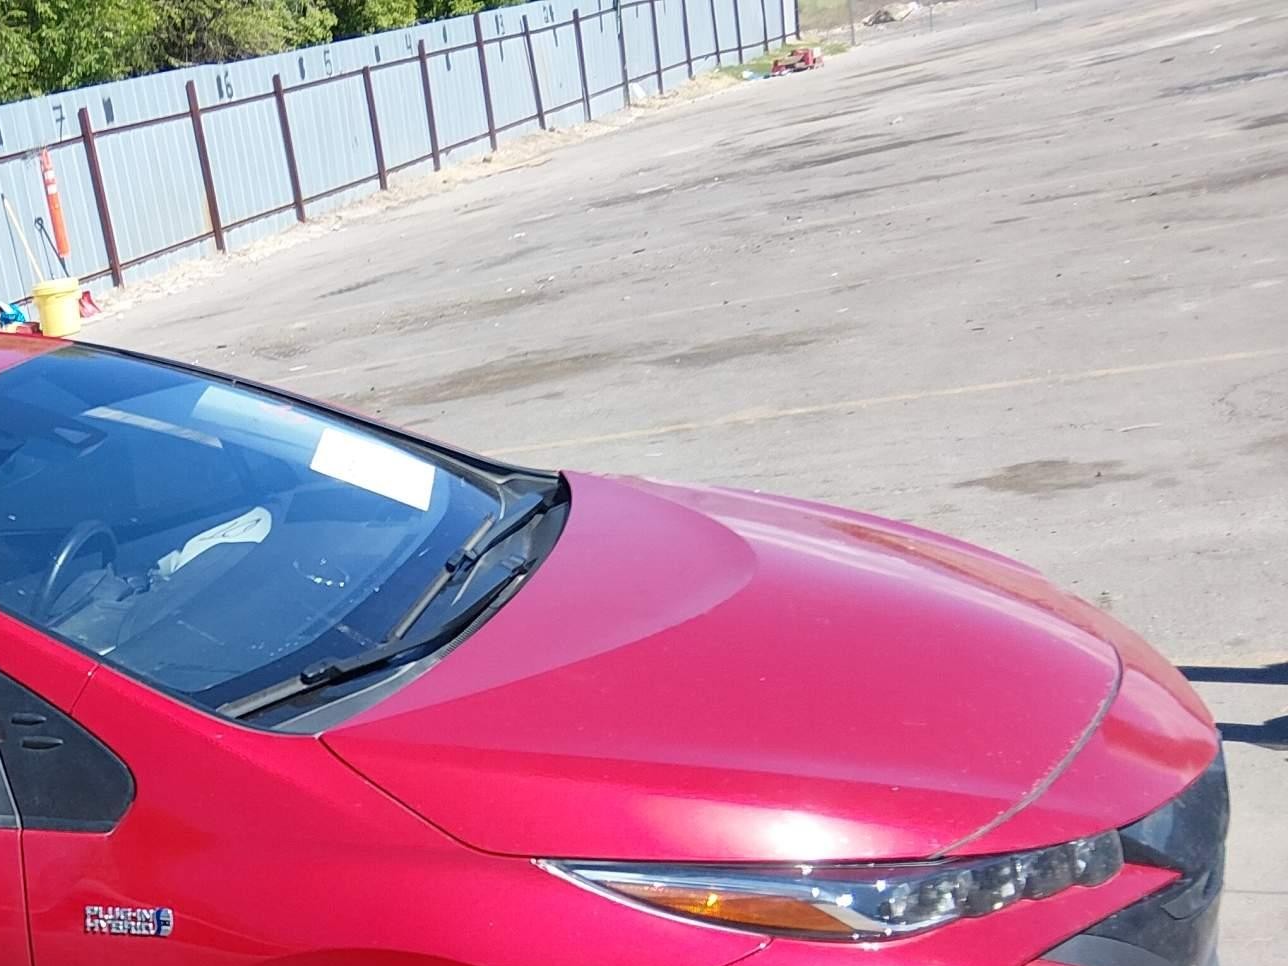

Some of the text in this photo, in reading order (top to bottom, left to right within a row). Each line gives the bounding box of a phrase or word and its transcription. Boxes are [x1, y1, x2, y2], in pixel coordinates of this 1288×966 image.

[323, 49, 333, 76] 5
[224, 71, 234, 99] 6
[52, 104, 65, 141] 7
[84, 905, 155, 923] PLUG-IN
[85, 917, 156, 935] HYBRID
